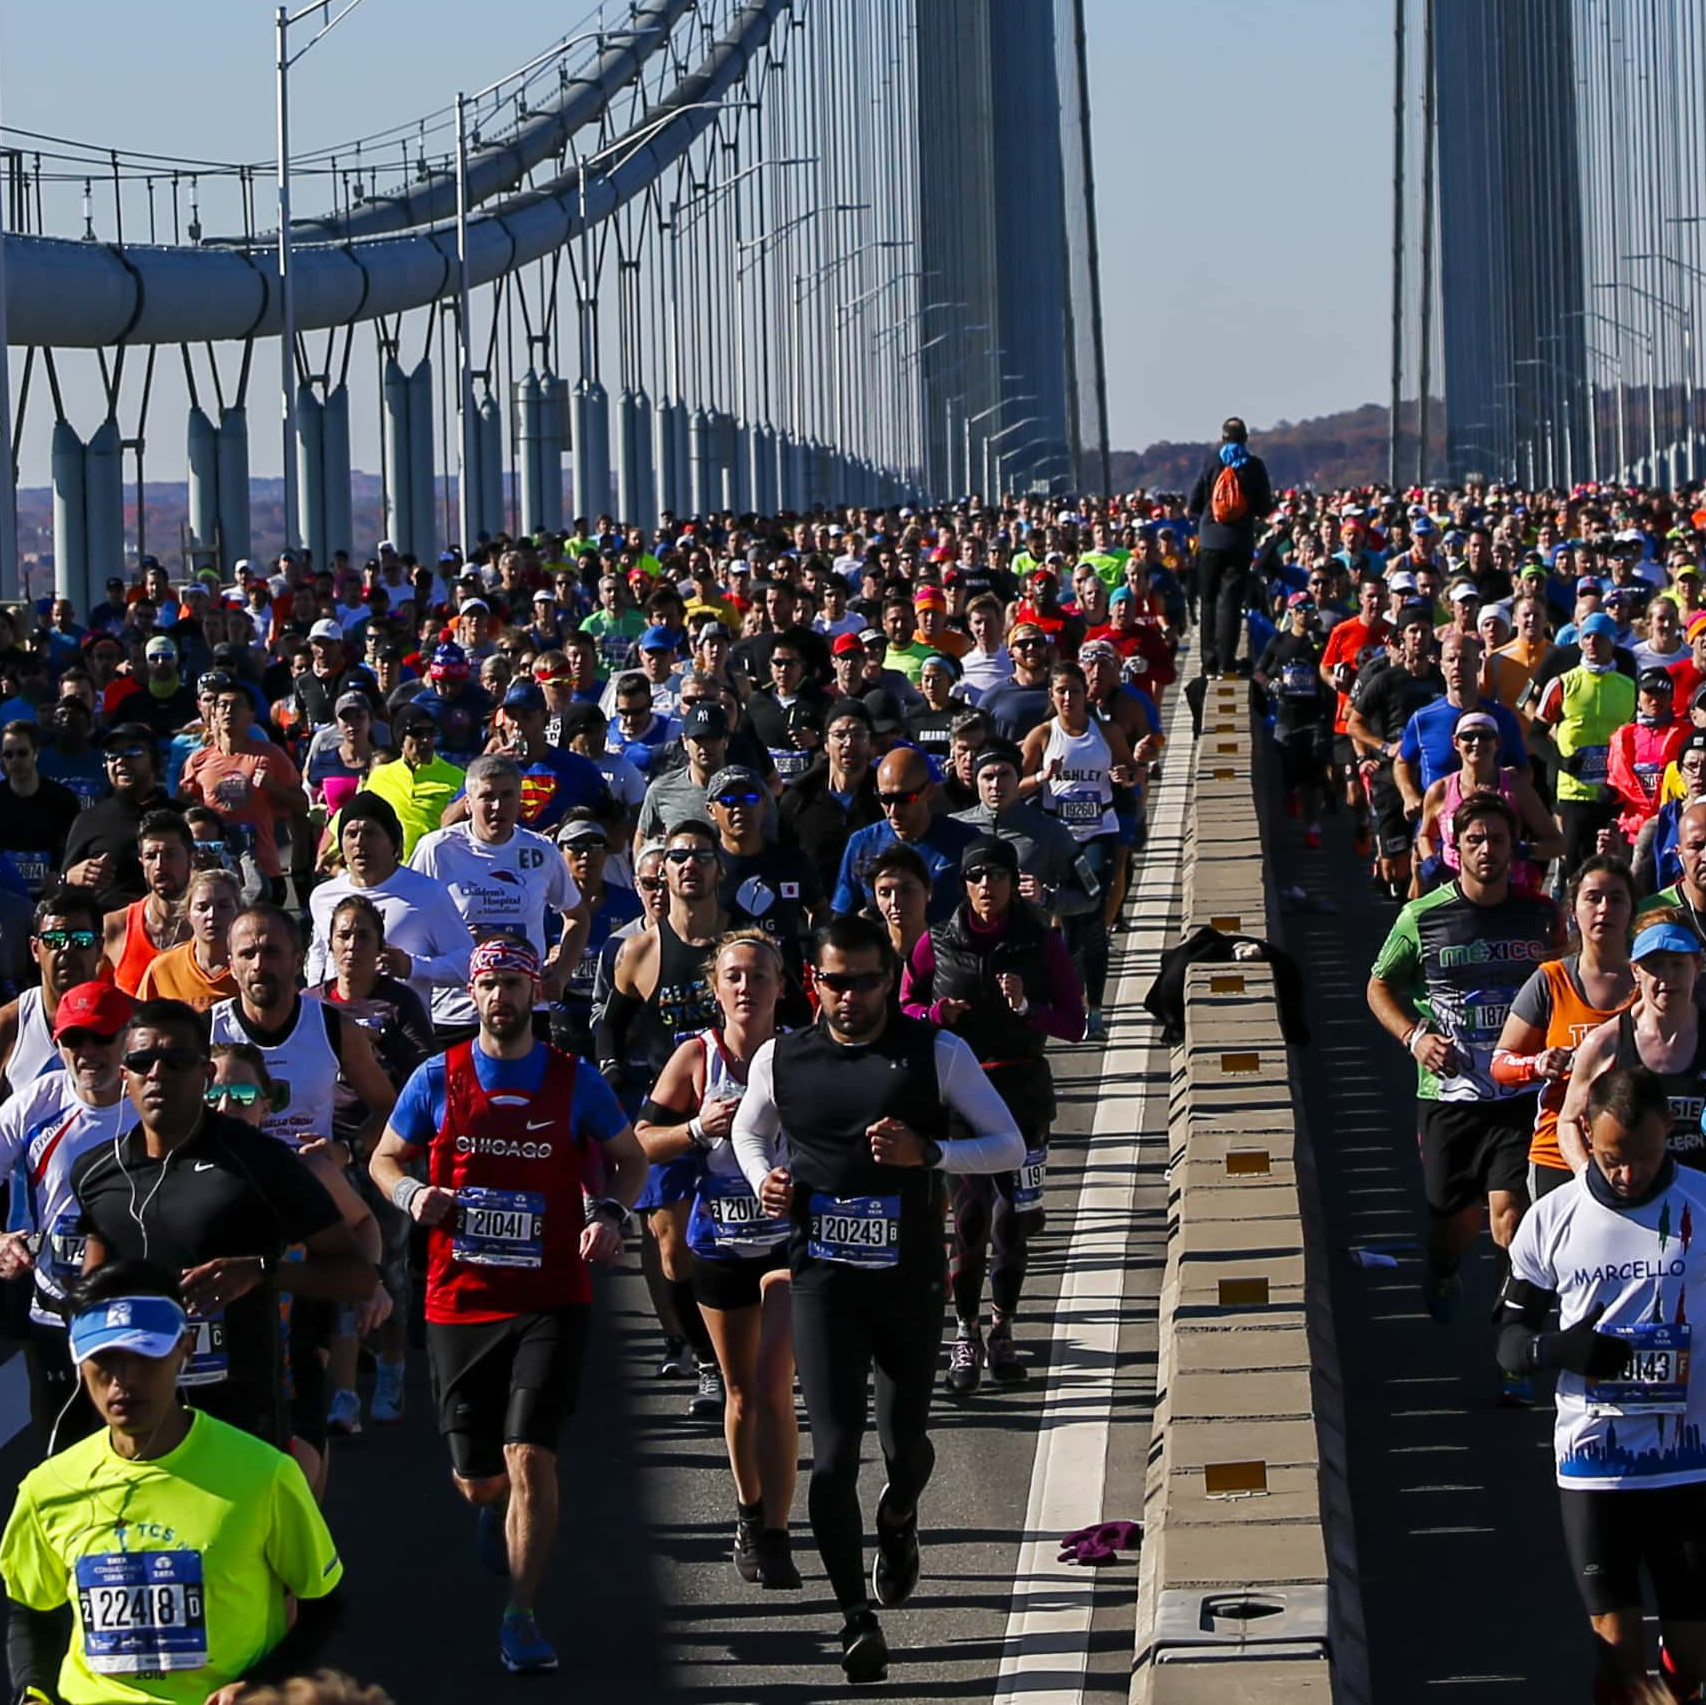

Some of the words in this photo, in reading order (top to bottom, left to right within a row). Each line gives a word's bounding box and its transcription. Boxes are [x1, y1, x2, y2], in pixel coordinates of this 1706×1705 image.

[1054, 770, 1102, 783] ASHLEY
[1066, 802, 1095, 817] 19260
[518, 847, 545, 870] ED
[482, 895, 521, 908] Hospital
[455, 1135, 553, 1159] CHICAGO
[712, 1204, 720, 1219] 2
[456, 1213, 464, 1229] 2
[473, 1210, 524, 1239] 21041
[534, 1221, 542, 1236] C
[826, 1220, 885, 1246] 20243
[1574, 1259, 1686, 1287] MARCELLO
[136, 1523, 176, 1543] TCS
[153, 1569, 176, 1579] TATA
[81, 1599, 93, 1624] 2
[99, 1586, 178, 1628] 22418
